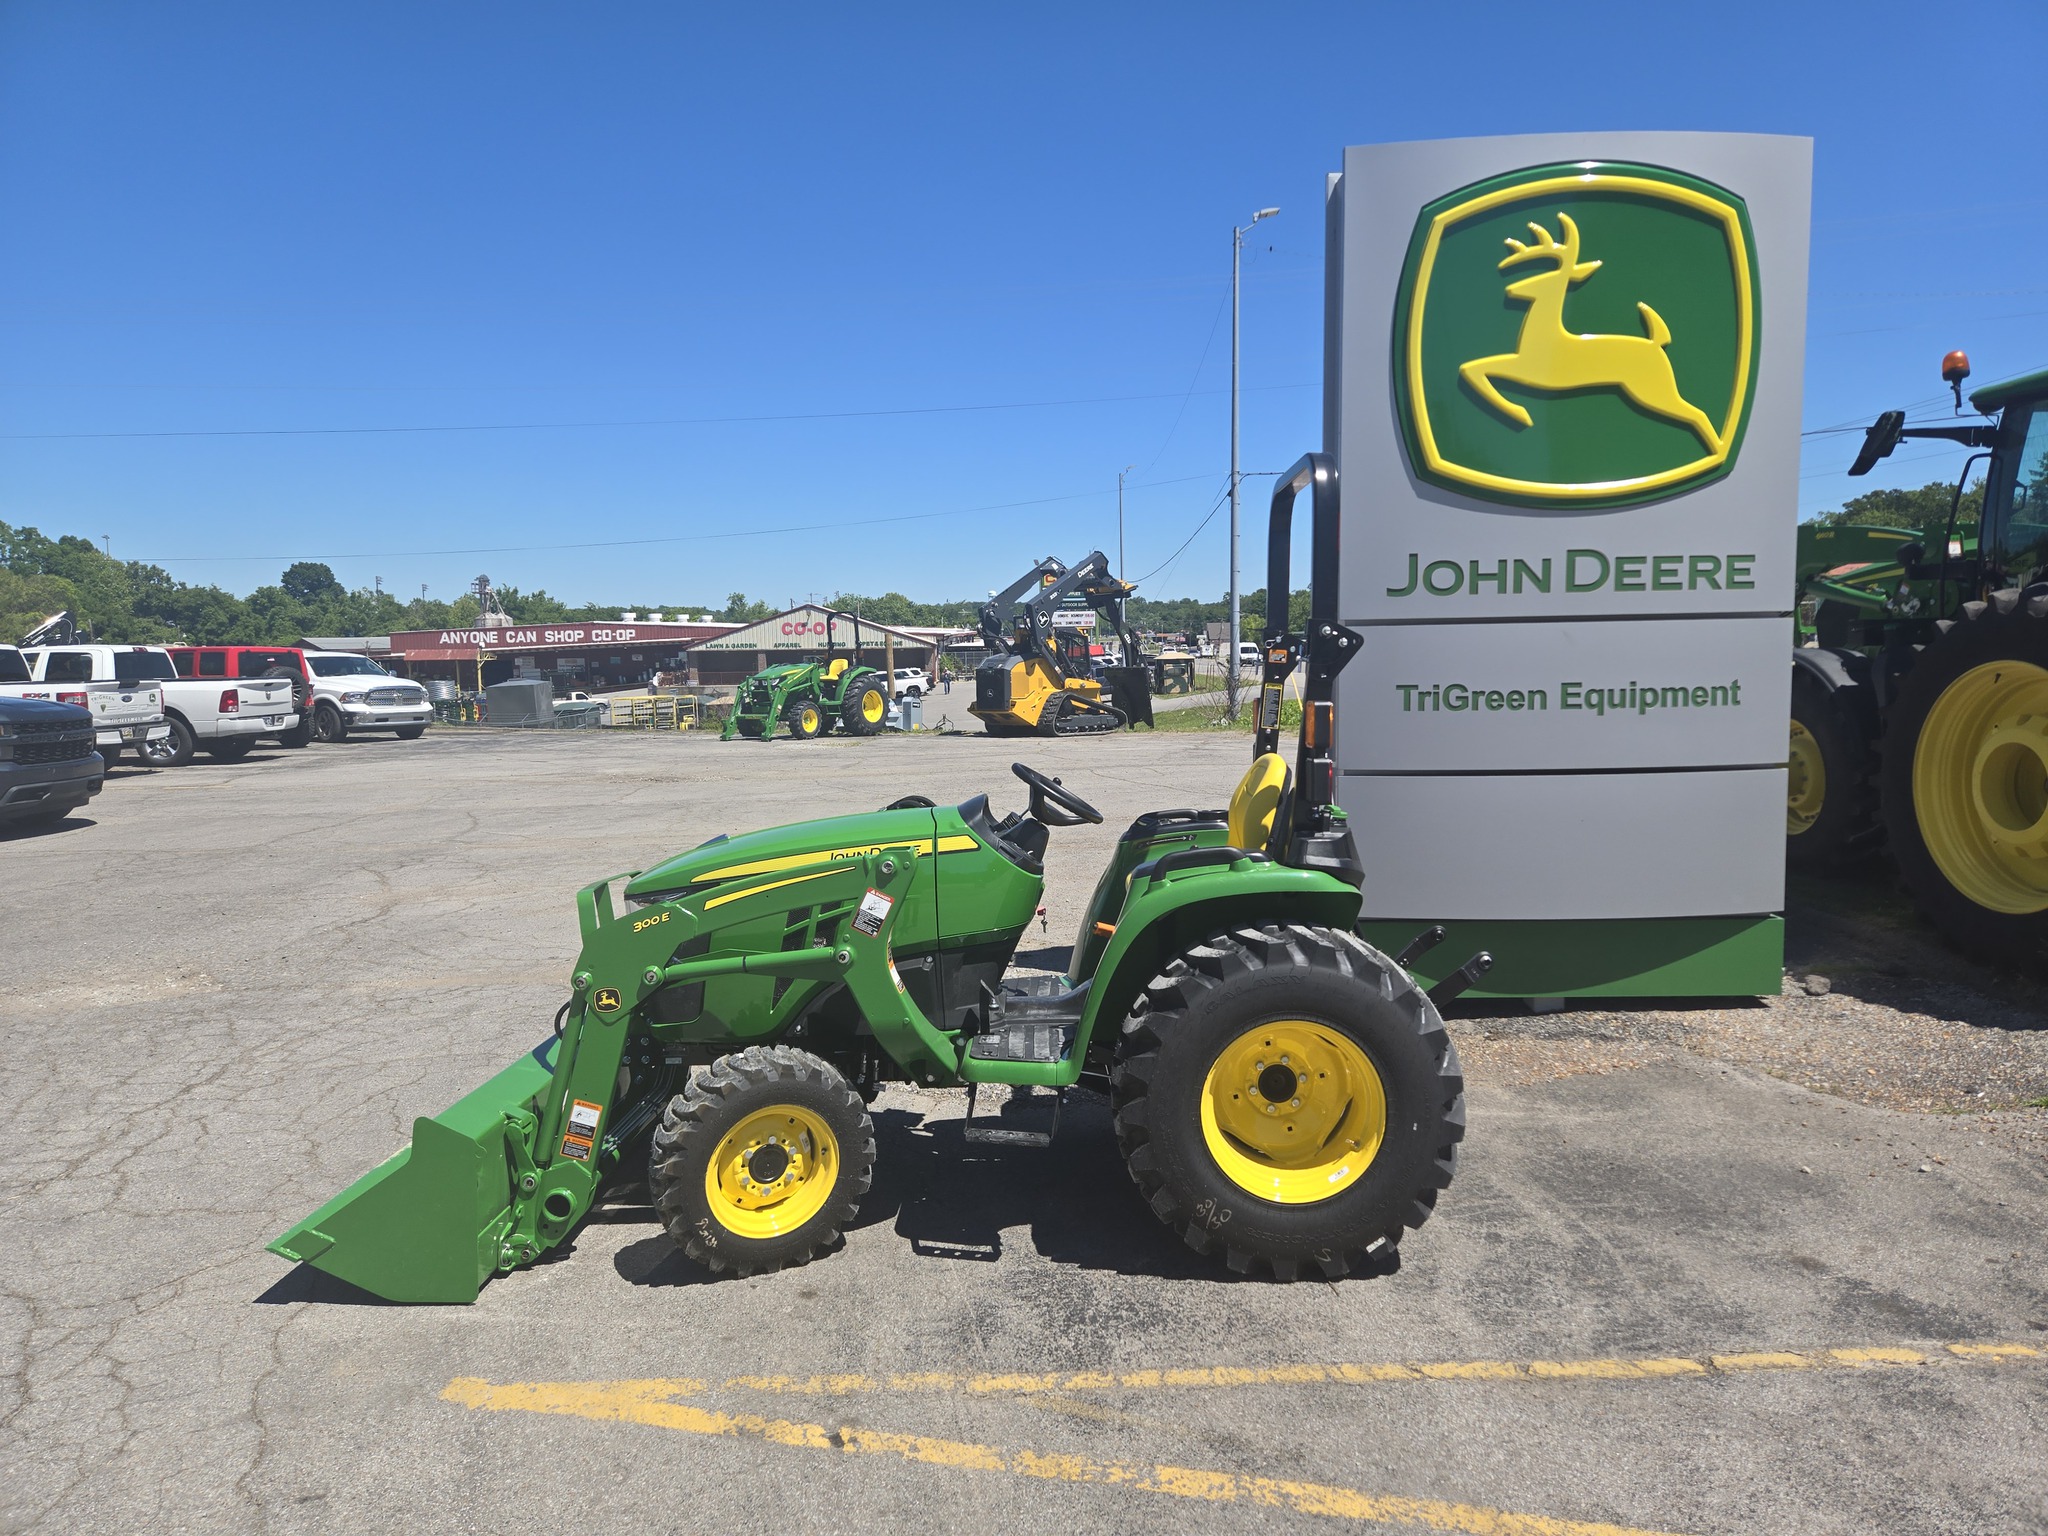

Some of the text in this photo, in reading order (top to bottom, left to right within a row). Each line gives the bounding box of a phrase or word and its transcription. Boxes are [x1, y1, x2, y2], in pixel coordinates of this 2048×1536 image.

[1386, 548, 1757, 598] JOHN DEERE
[439, 629, 636, 644] ANYONE CAN SHOP CO-OP
[781, 621, 837, 635] CO-OP
[1396, 679, 1742, 717] TriGreen Equipment
[633, 911, 671, 933] 300 E
